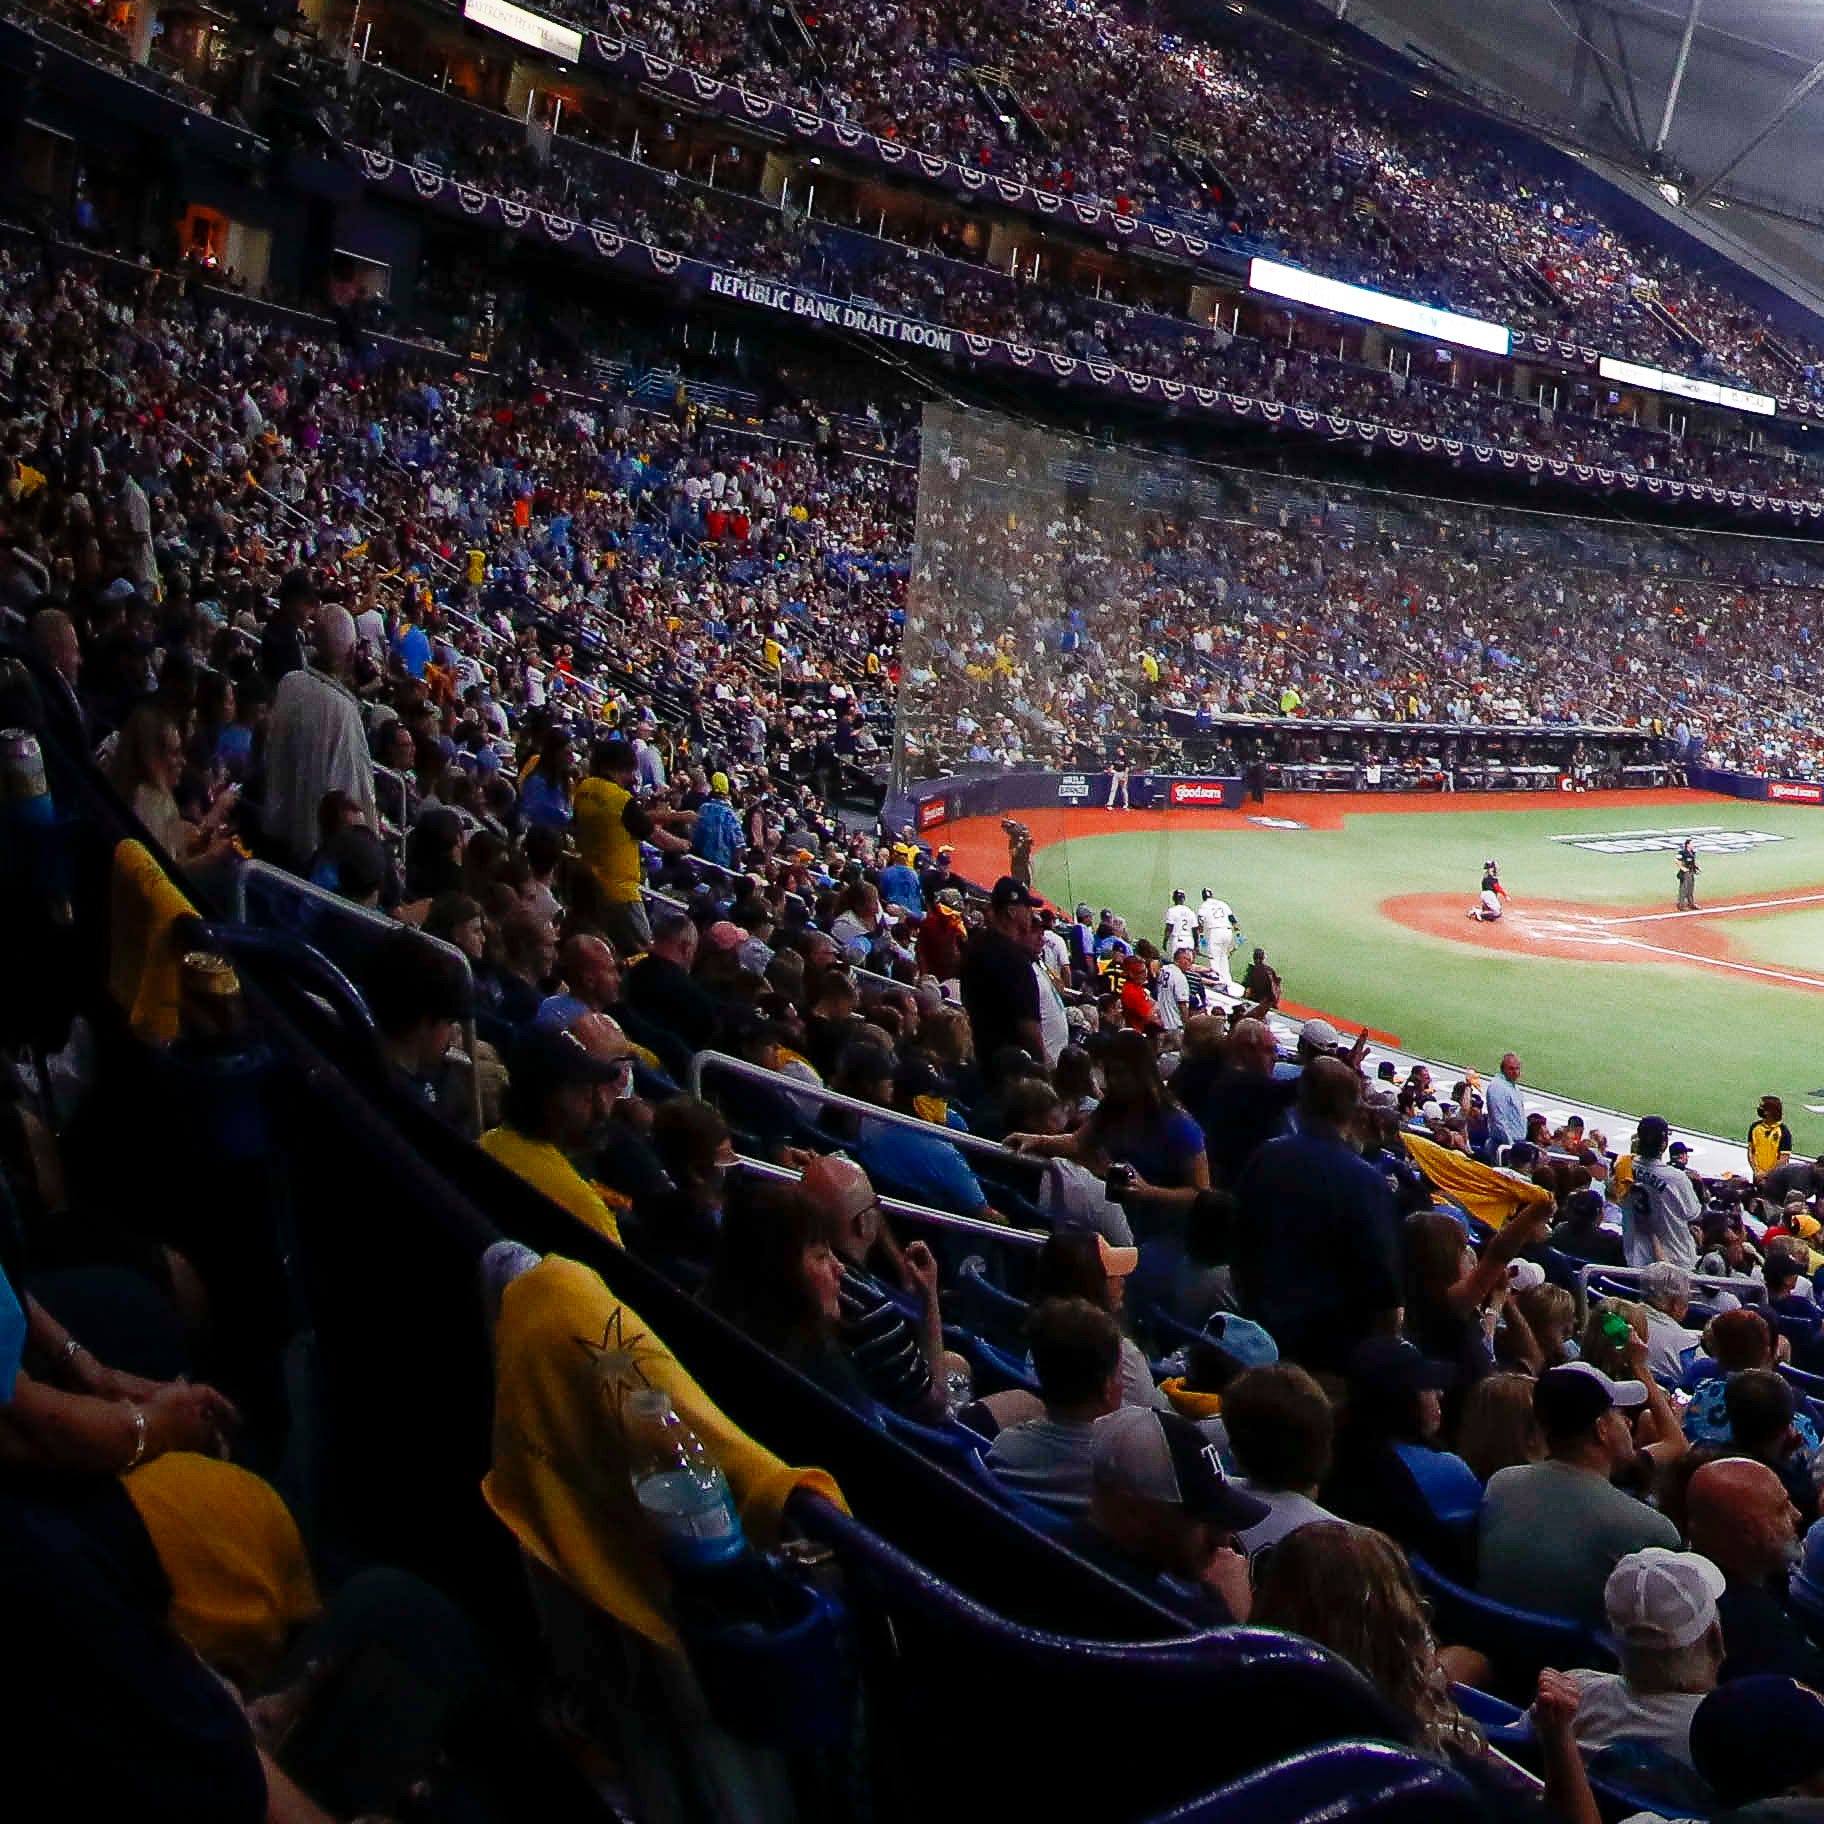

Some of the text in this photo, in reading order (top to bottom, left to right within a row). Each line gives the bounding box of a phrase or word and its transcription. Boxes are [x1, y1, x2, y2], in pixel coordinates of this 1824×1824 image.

[711, 272, 951, 352] REPUBLIC BANK DRAFT ROOM
[1174, 784, 1221, 803] goodsam
[1181, 918, 1188, 933] 2
